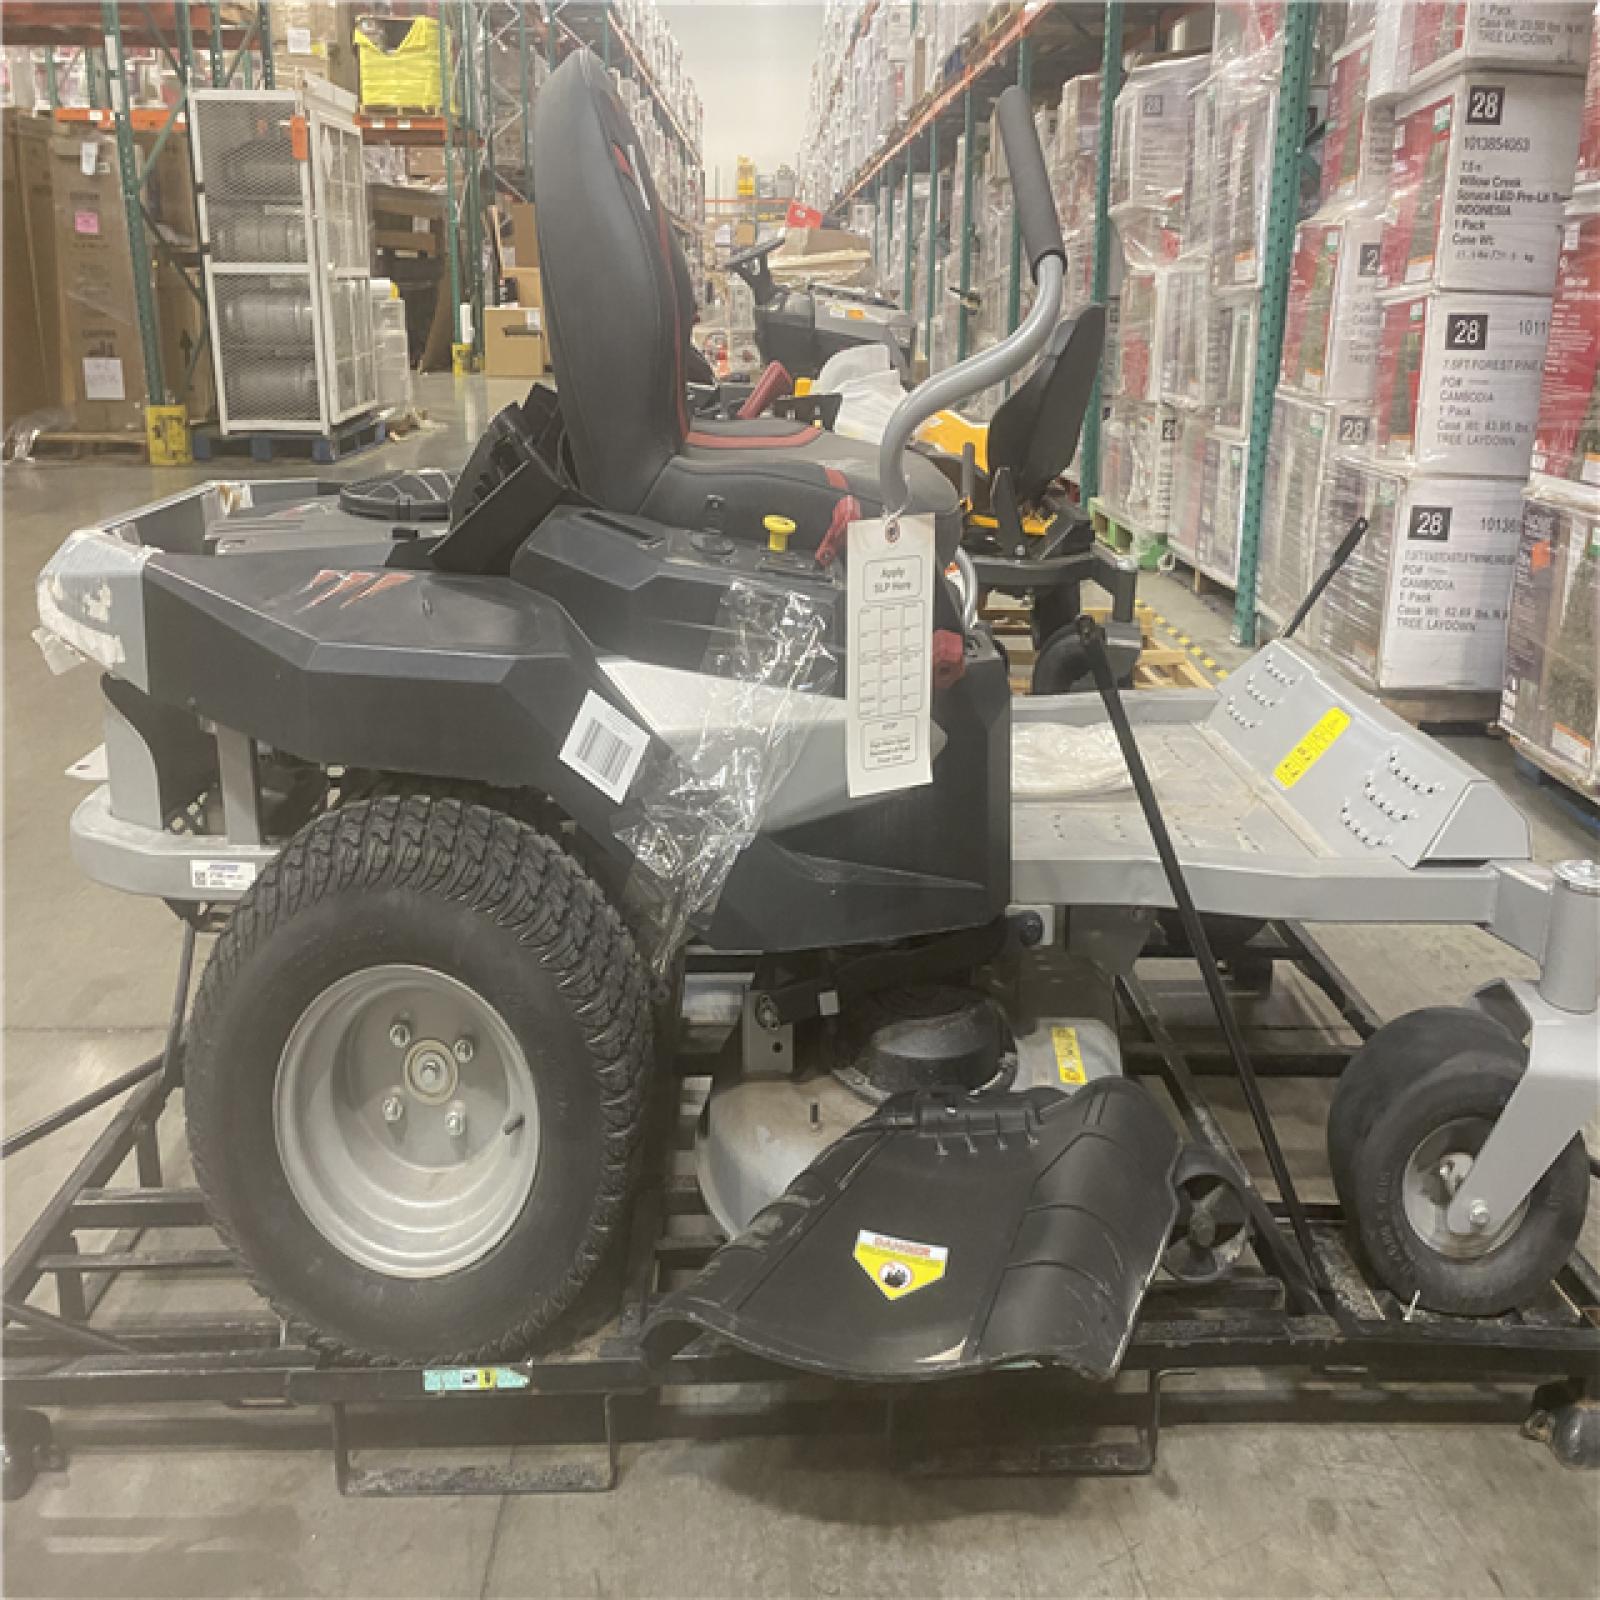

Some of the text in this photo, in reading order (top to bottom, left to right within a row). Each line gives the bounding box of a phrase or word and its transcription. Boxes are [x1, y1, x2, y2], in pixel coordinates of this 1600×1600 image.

[1471, 92, 1499, 119] 28
[1459, 174, 1491, 187] Willow
[1455, 203, 1511, 216] INDONESIA
[1462, 219, 1486, 231] Pack
[1452, 232, 1476, 246] Case
[1454, 319, 1481, 344] 28
[1440, 390, 1494, 403] CAMBODIA
[1448, 404, 1472, 416] Pack
[1437, 432, 1517, 446] TREE LAYDOWN
[1416, 511, 1444, 536] 28
[1399, 577, 1454, 591] CAMBODIA
[1409, 592, 1431, 603] Pack
[1397, 616, 1476, 632] TREE LAYDOWN
